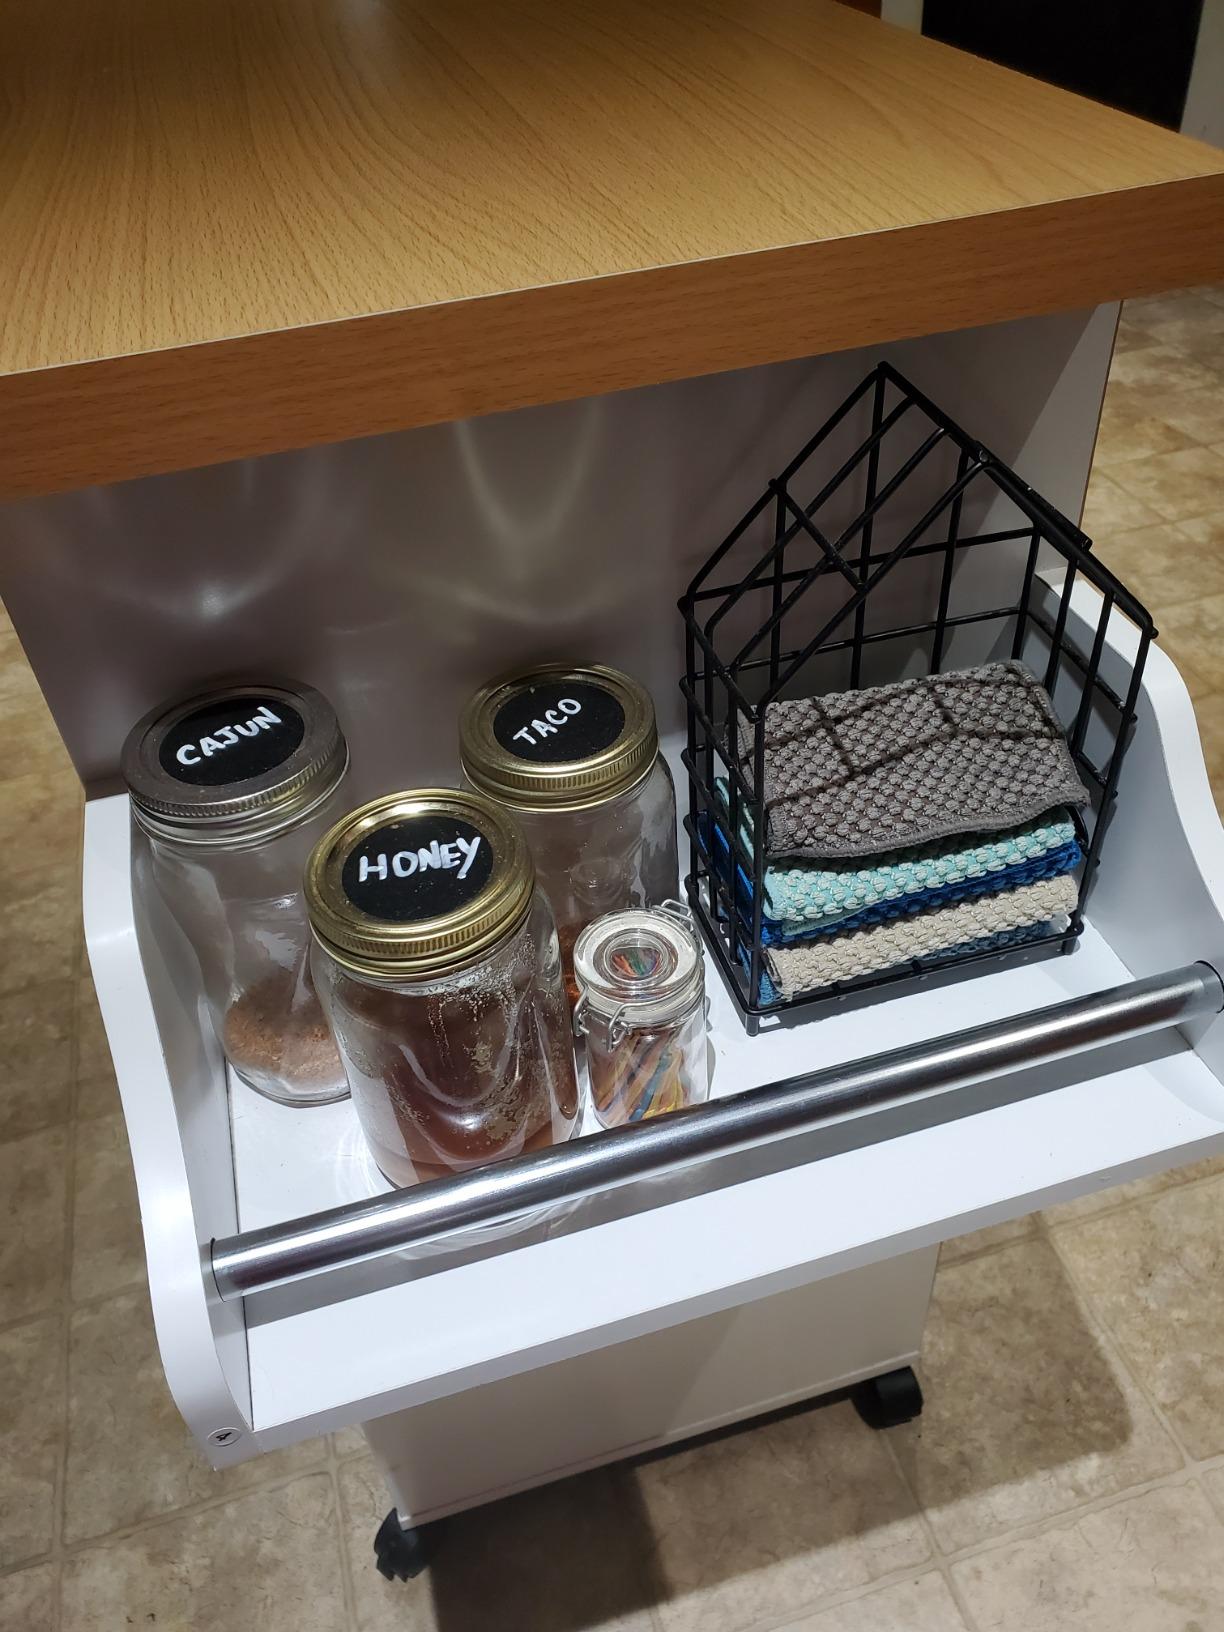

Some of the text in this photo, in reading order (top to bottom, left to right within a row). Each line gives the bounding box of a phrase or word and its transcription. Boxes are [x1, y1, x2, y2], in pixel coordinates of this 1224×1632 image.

[175, 705, 283, 766] CAJUN
[512, 698, 583, 746] TACO
[357, 835, 482, 882] HONEY
